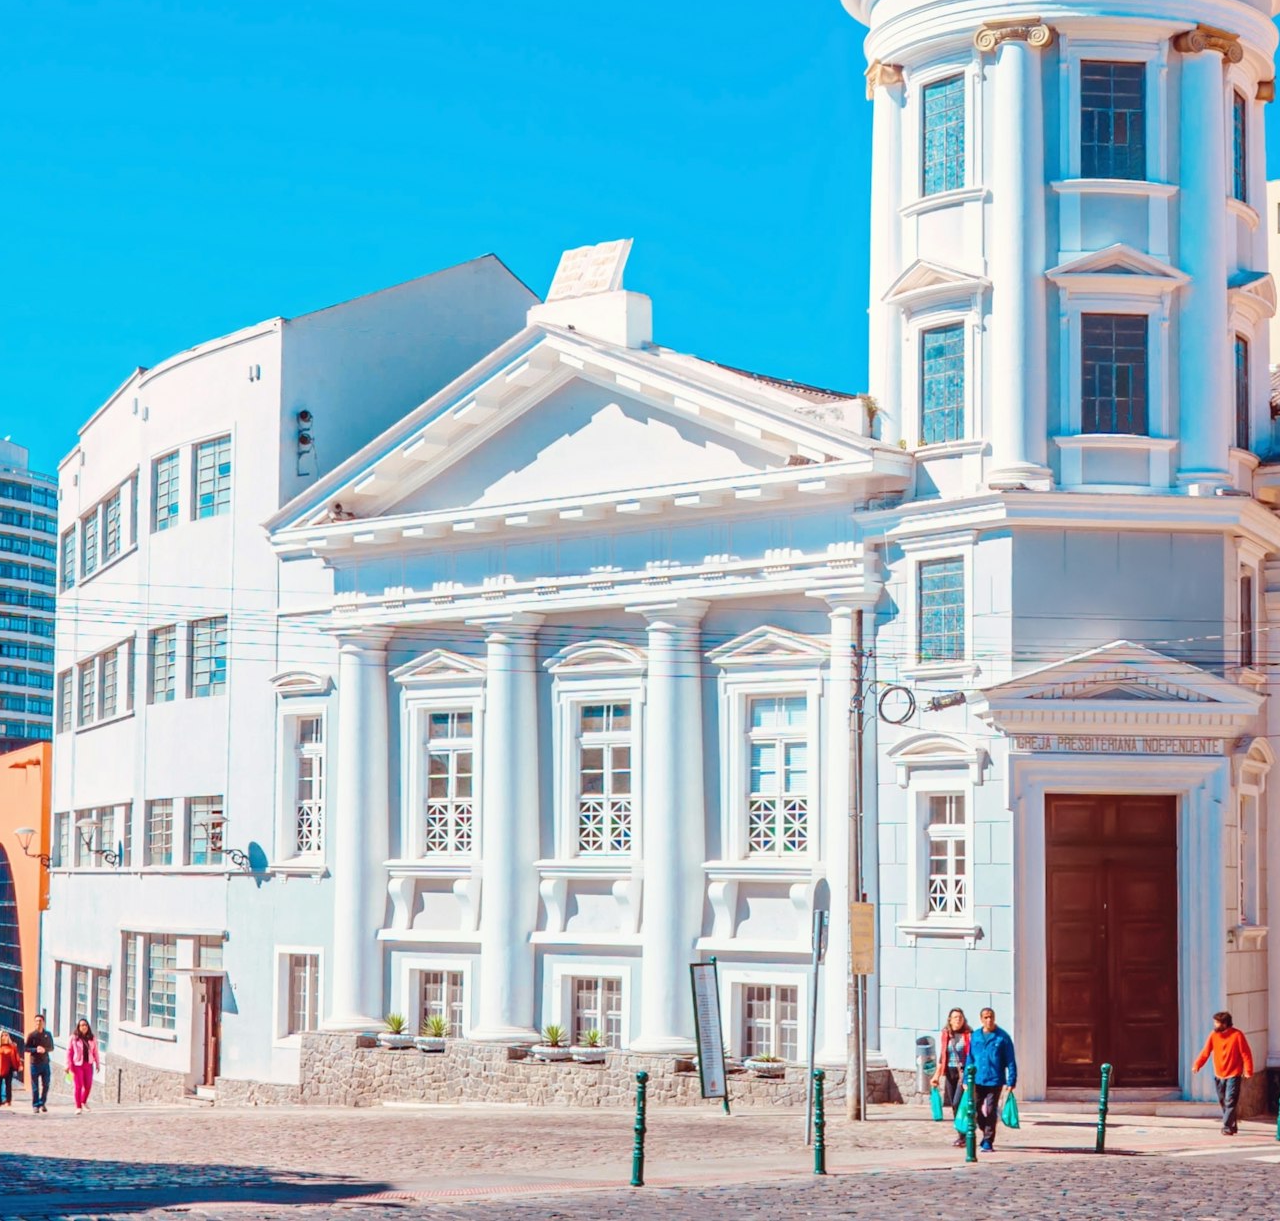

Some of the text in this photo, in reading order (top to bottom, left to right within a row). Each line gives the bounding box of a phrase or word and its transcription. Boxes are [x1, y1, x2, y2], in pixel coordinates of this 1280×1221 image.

[1016, 735, 1220, 754] IGREJA PRESBITERIANA INDEPENDENTE
